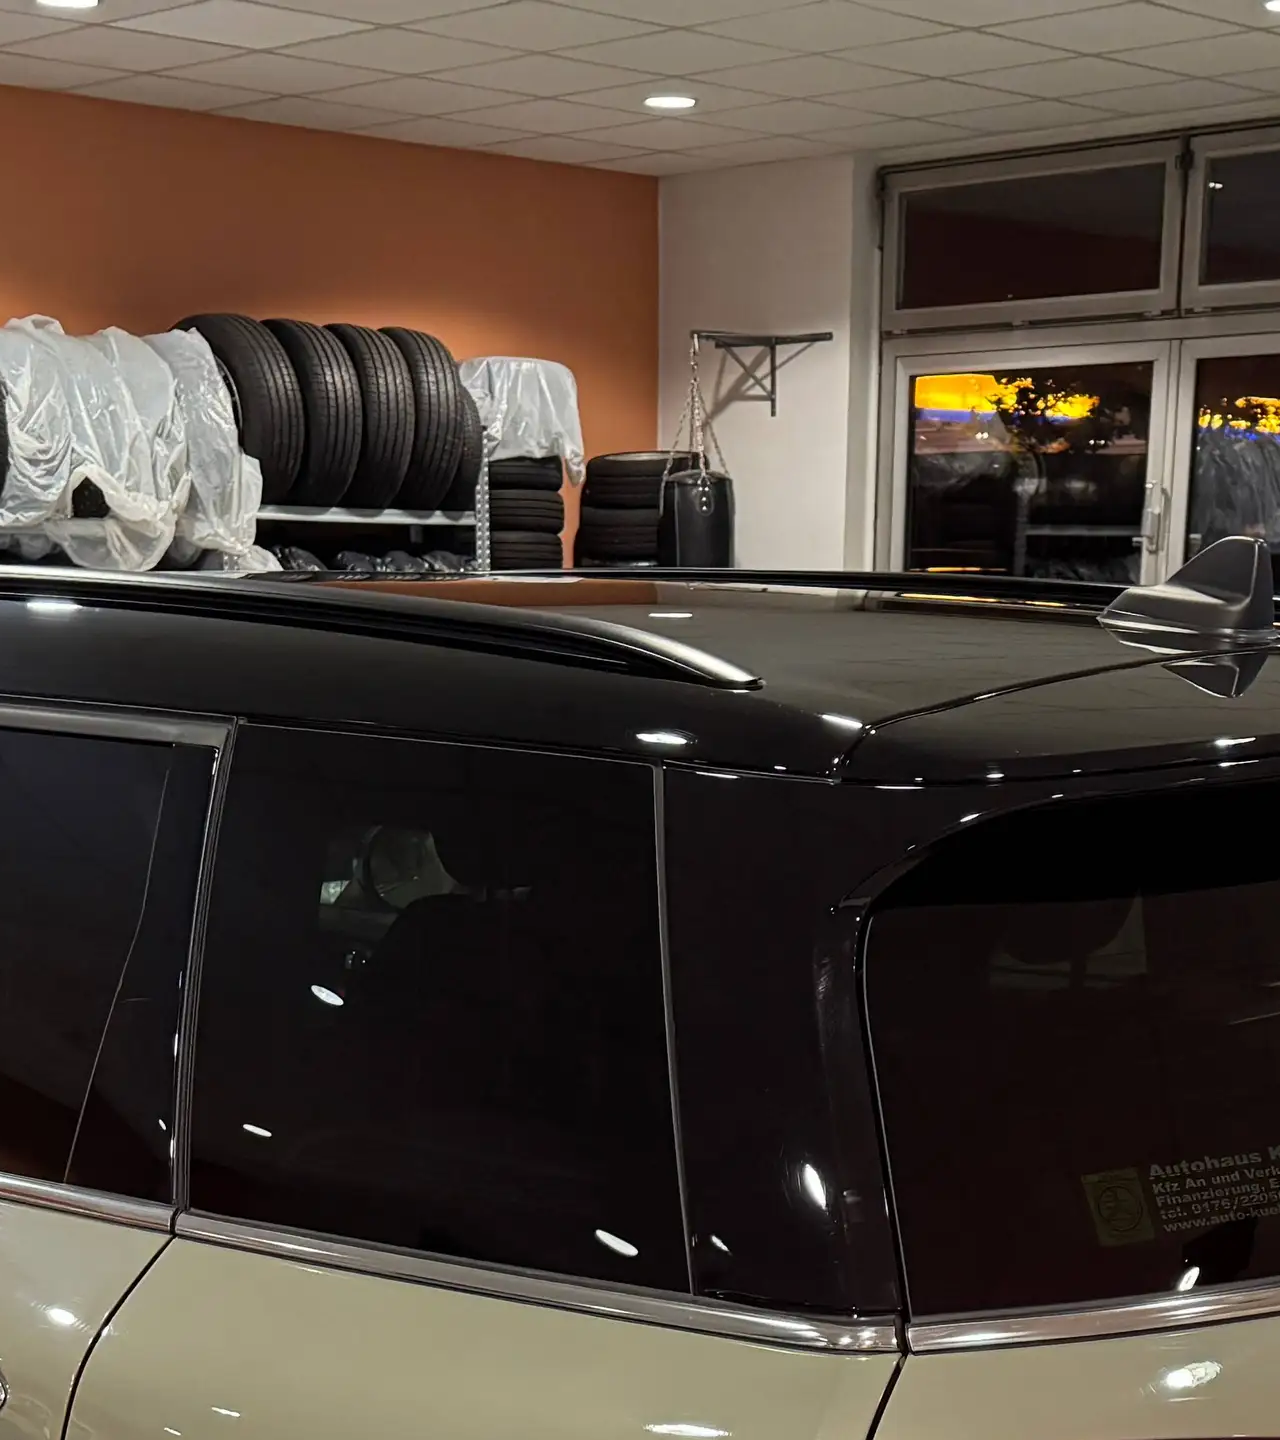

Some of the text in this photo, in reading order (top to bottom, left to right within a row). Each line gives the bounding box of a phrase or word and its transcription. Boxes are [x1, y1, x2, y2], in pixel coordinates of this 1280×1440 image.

[1149, 1151, 1263, 1180] Autohaus
[1152, 1181, 1181, 1195] Kfz
[1185, 1177, 1207, 1190] An
[1211, 1170, 1241, 1185] und
